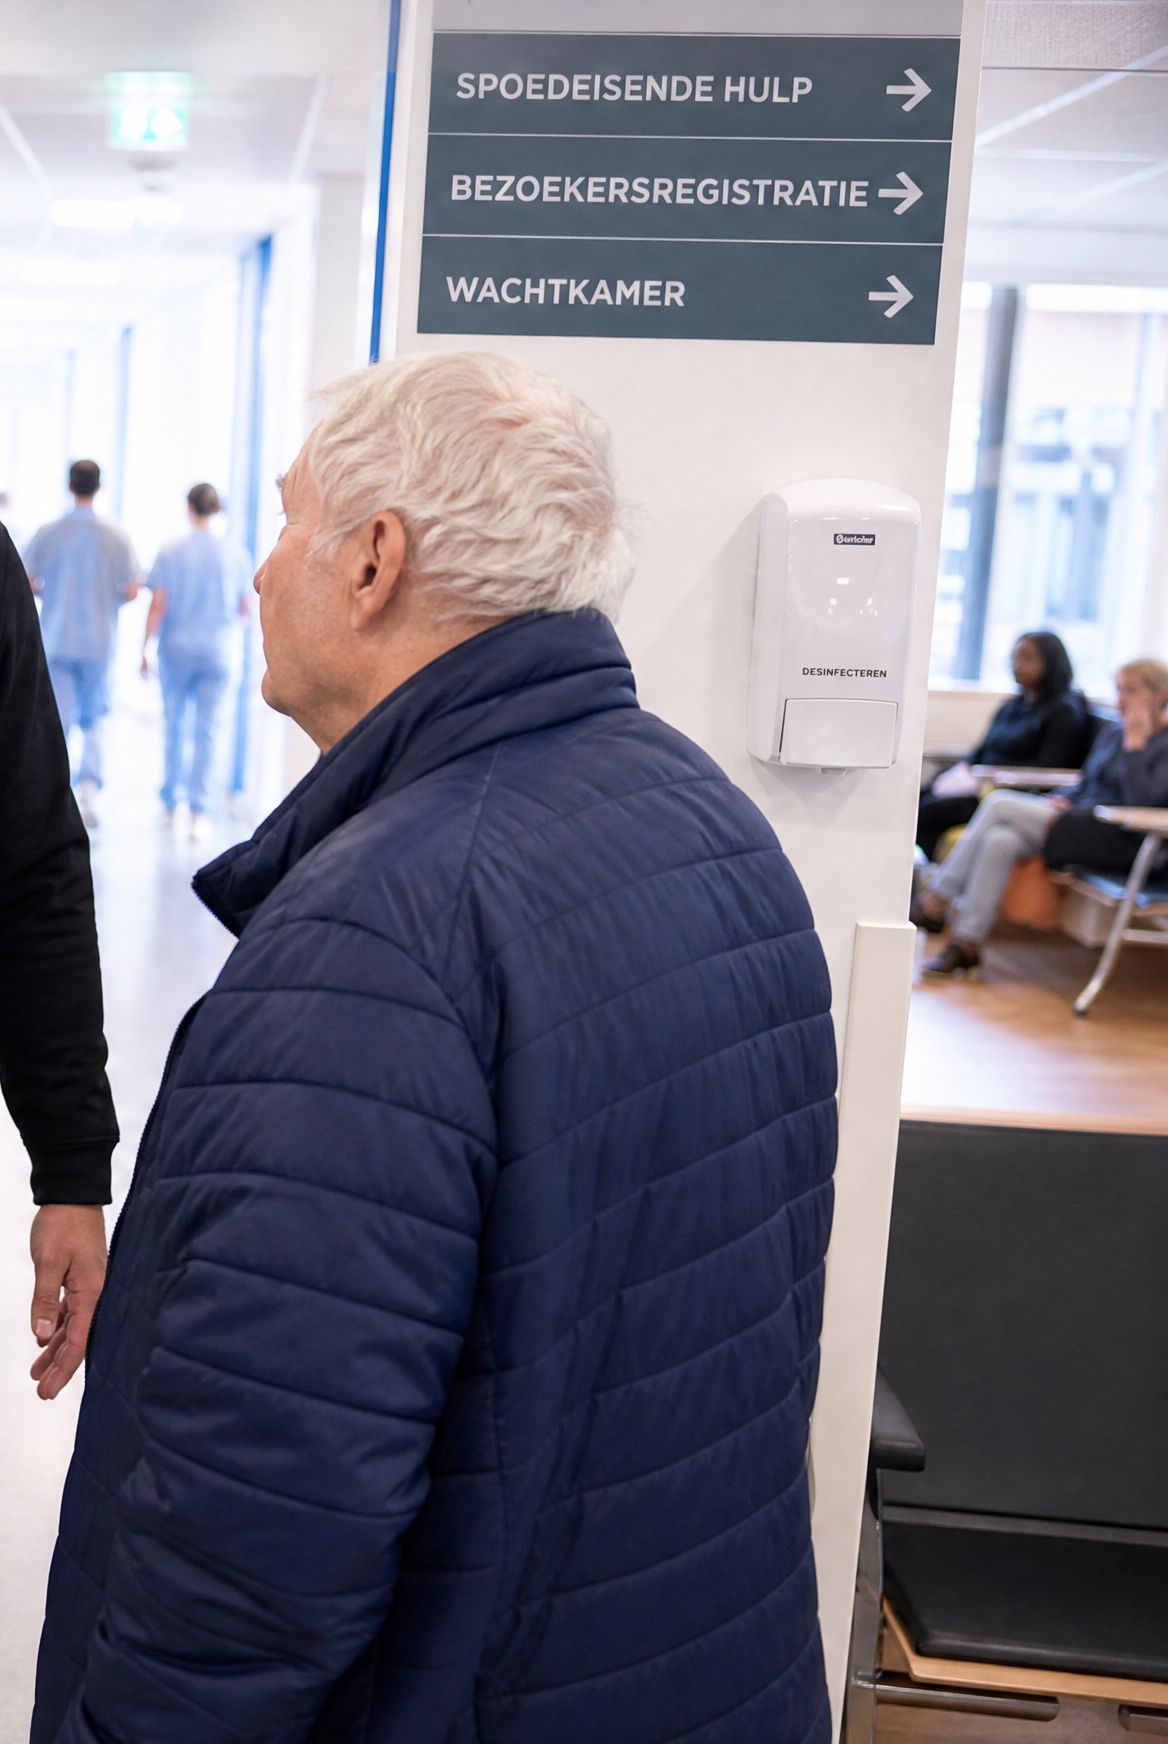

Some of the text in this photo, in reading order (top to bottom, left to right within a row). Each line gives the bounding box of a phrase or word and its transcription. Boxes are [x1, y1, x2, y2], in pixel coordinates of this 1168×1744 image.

[456, 73, 812, 103] SPOEDEISENDE HULP
[451, 175, 869, 207] BEZOEKERSREGISTRATIE
[446, 277, 685, 307] WACHTKAMER
[802, 667, 887, 678] DESINFECTEREN
